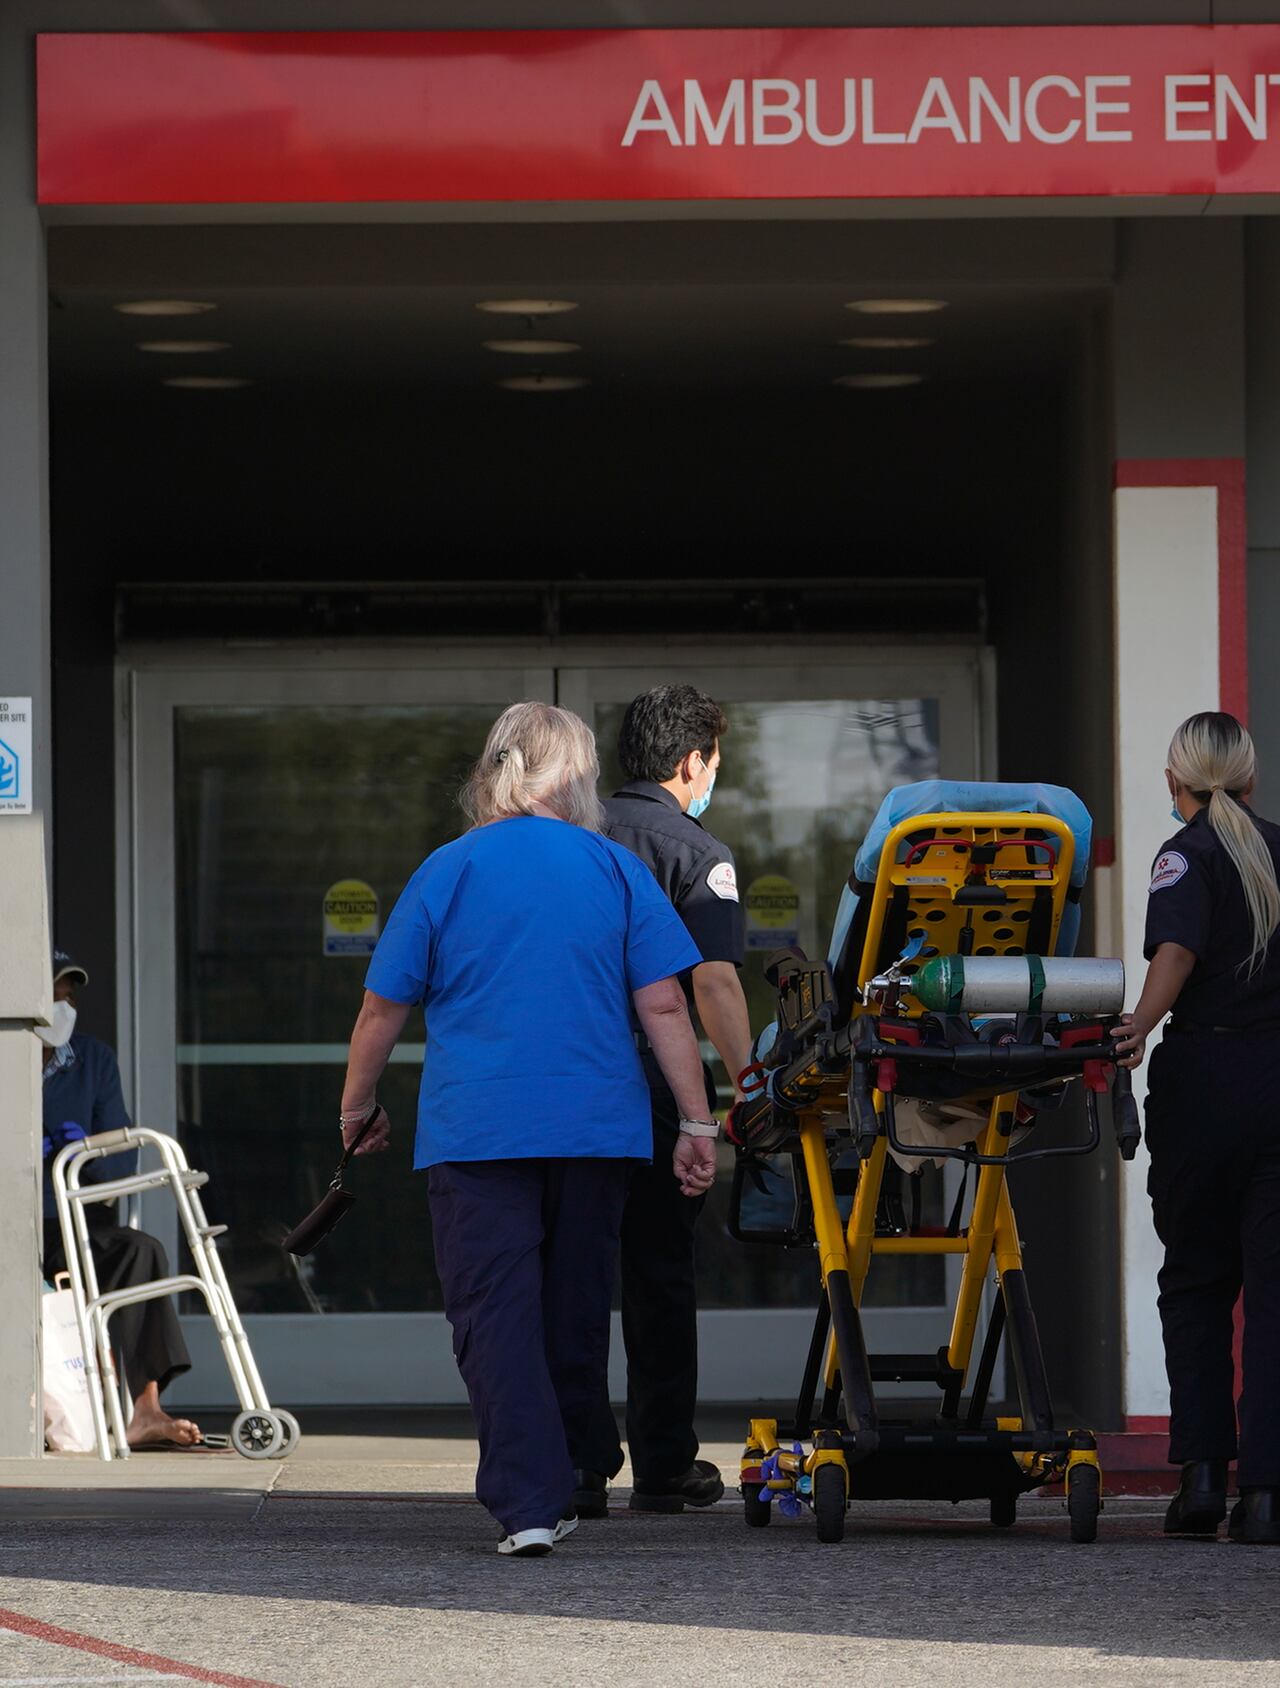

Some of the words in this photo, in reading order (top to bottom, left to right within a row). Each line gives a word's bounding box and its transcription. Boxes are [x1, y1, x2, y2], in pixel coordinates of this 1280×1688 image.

[621, 73, 1132, 147] AMBULANCE
[11, 713, 26, 722] SITE
[326, 902, 376, 913] CAUTION
